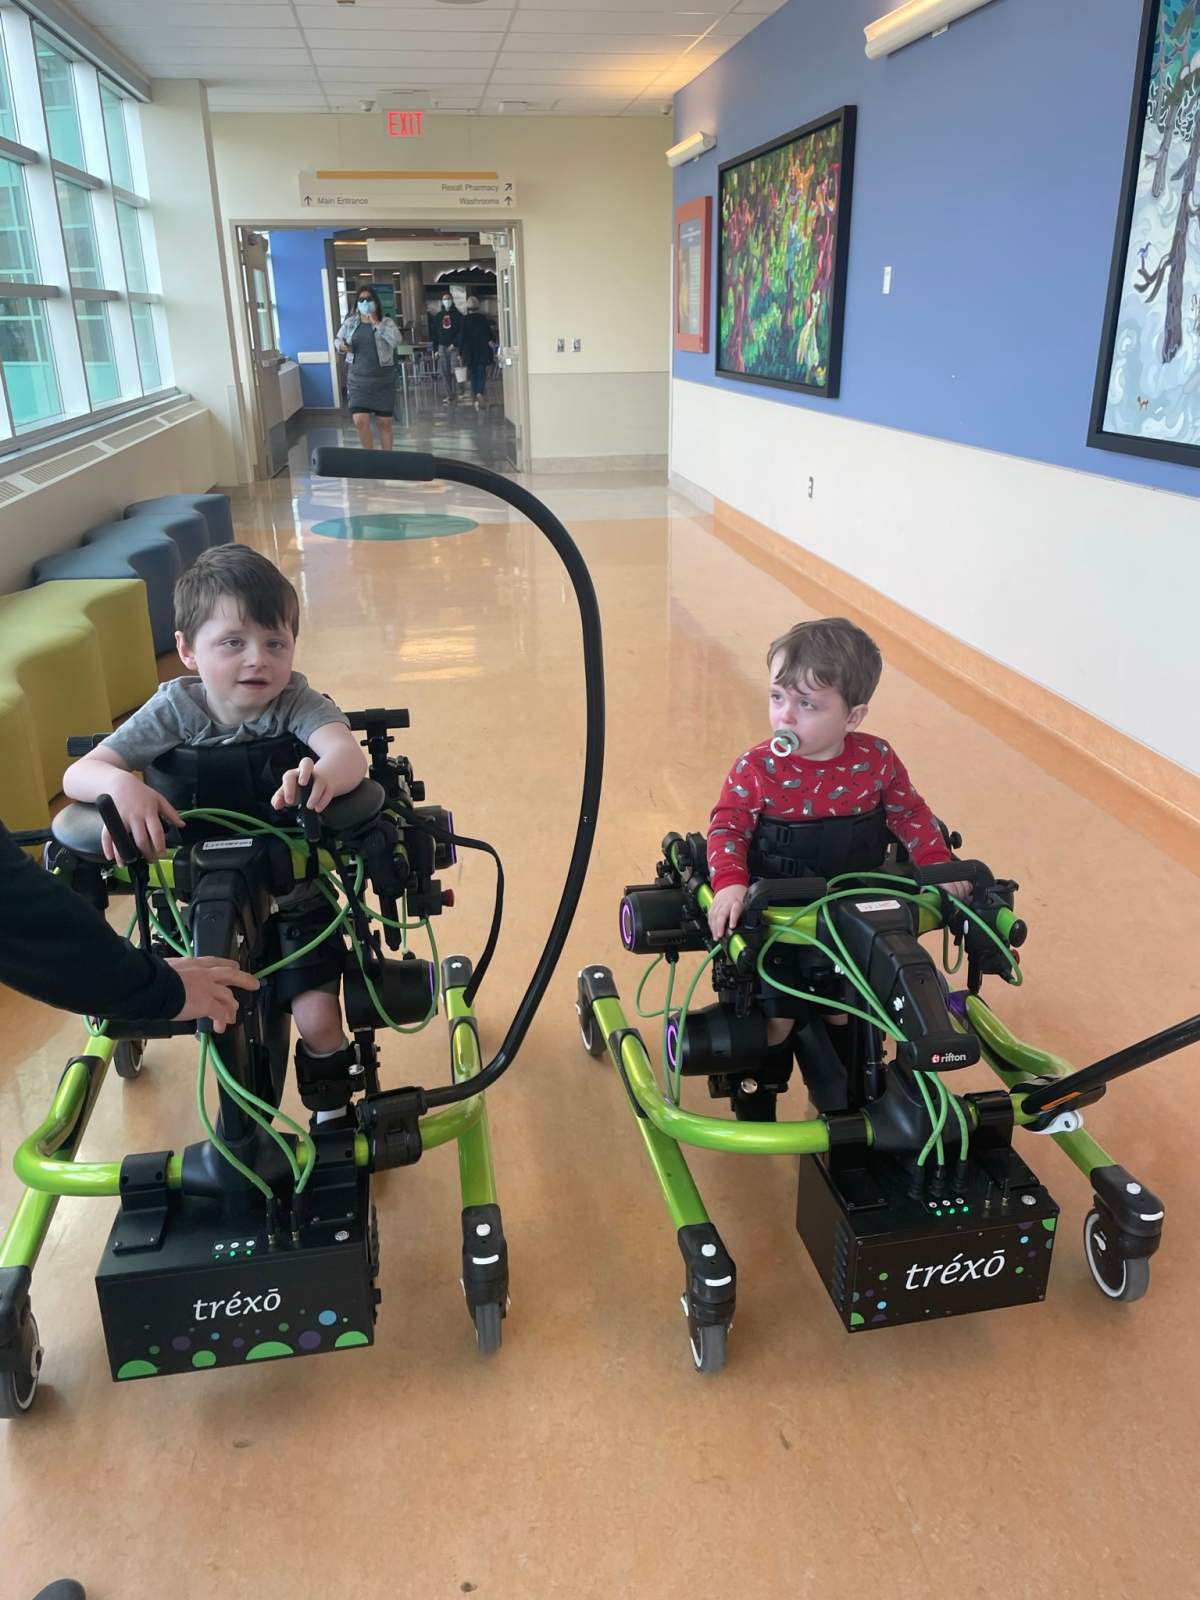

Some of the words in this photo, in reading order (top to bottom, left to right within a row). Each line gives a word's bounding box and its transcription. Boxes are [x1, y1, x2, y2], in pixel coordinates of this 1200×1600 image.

[387, 111, 423, 137] EXIT
[465, 183, 499, 193] Pharmacy
[317, 196, 336, 205] Main
[336, 196, 369, 205] Entrance
[459, 196, 500, 205] Washrooms
[940, 1052, 967, 1063] rifton
